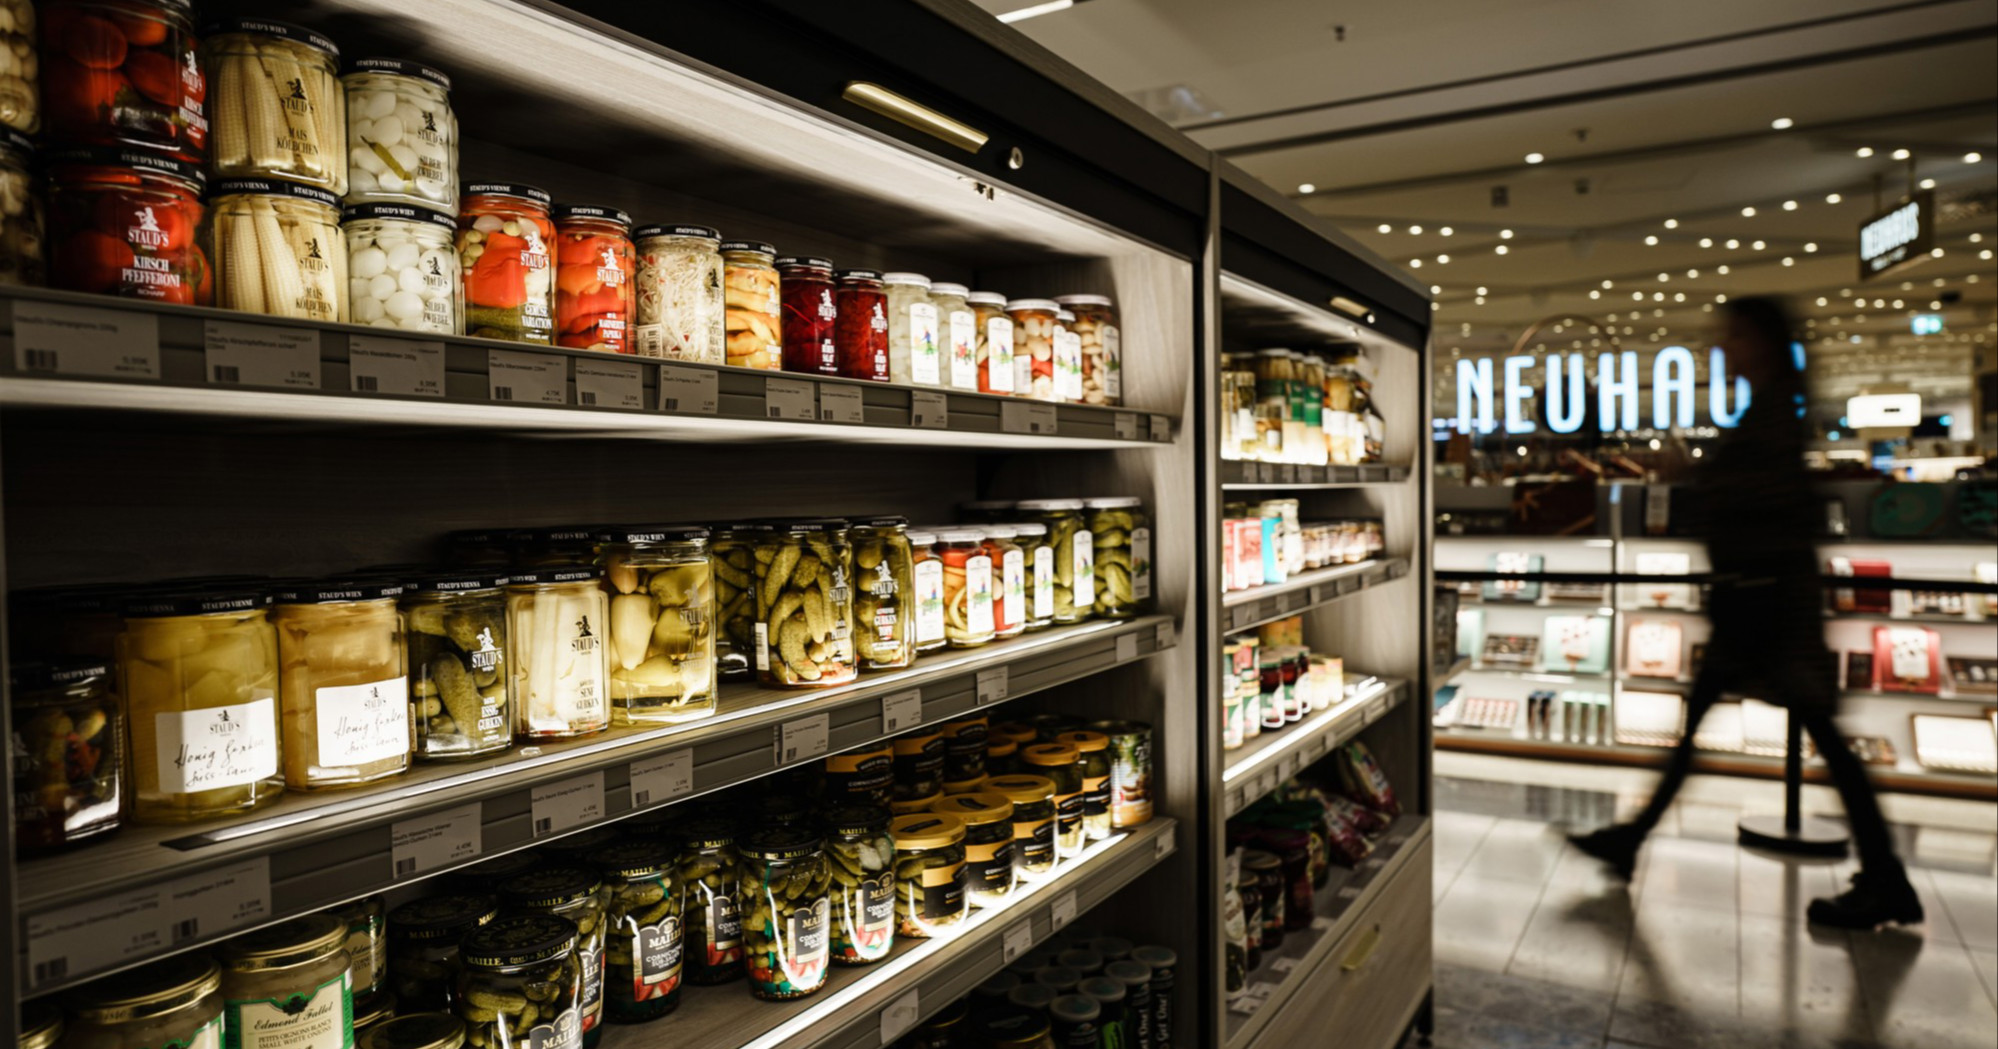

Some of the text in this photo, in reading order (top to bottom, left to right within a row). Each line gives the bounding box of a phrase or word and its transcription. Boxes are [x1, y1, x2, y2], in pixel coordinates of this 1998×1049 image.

[282, 98, 314, 114] STAUD'S
[289, 128, 307, 139] MAIS
[418, 129, 443, 144] STAUD'S
[154, 158, 178, 171] VIENNE
[374, 206, 415, 217] STAUD'S WIEN
[128, 230, 169, 246] STAUD'S
[134, 255, 169, 271] KIRSCH
[301, 259, 329, 272] STAUD'S
[521, 253, 549, 268] STAUD'S
[122, 268, 180, 287] PFEFFERONI
[597, 269, 625, 284] STAUD'S
[306, 288, 322, 300] MAIS
[1456, 346, 1806, 434] NEUHAU
[346, 590, 362, 598] WIEN
[871, 581, 899, 596] STAUD'S
[572, 637, 599, 652] STAUD'S
[472, 651, 503, 669] STAUD'S
[210, 722, 240, 734] STAUD'S
[334, 715, 369, 739] Honig
[175, 743, 215, 770] Honig
[621, 866, 655, 877] MAILLE
[254, 1001, 334, 1031] Edmond Fallot
[258, 1019, 332, 1043] PETITS OIGNONS BLANCS
[258, 1025, 332, 1049] SMALL WHITE ONIONS
